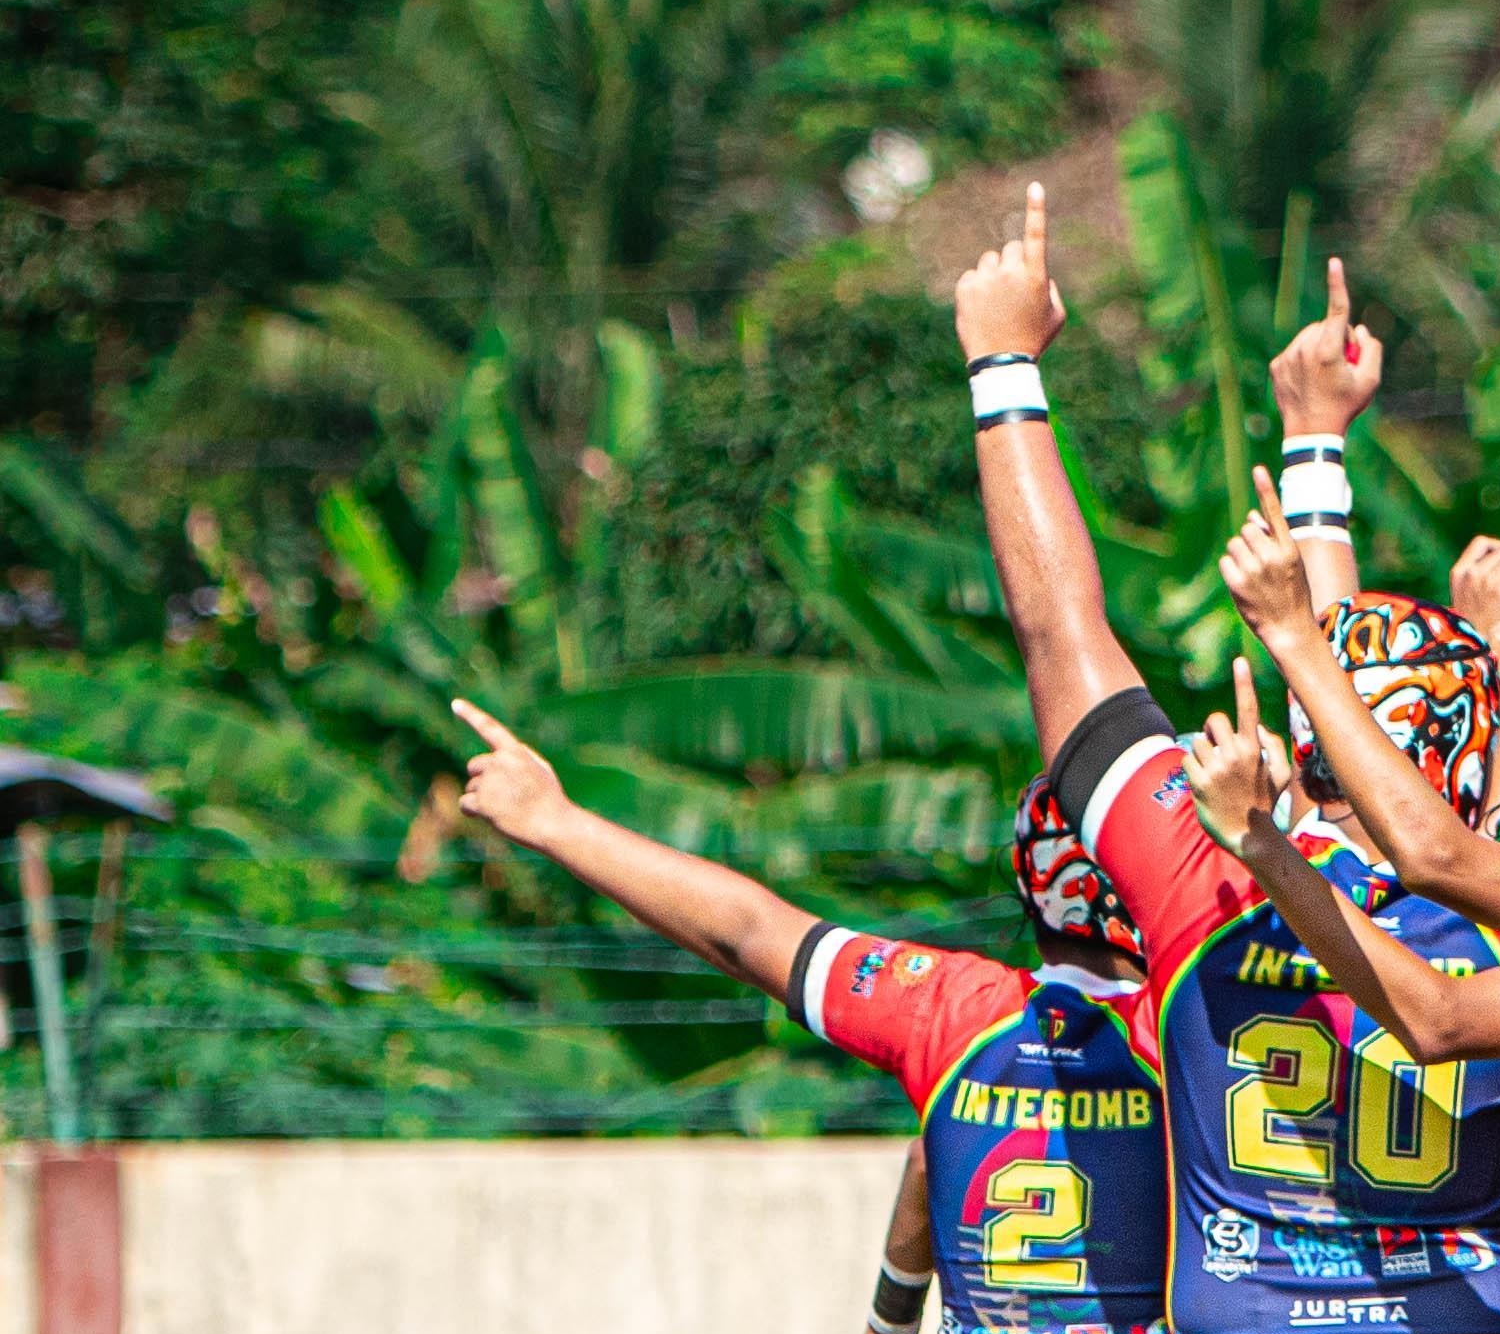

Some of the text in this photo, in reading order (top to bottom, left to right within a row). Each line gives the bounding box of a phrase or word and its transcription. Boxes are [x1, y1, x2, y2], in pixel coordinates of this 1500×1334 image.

[950, 1078, 1153, 1130] INTEGOMB
[1225, 1013, 1467, 1193] 20
[984, 1160, 1093, 1293] 2
[1289, 1298, 1410, 1324] JURTRA
